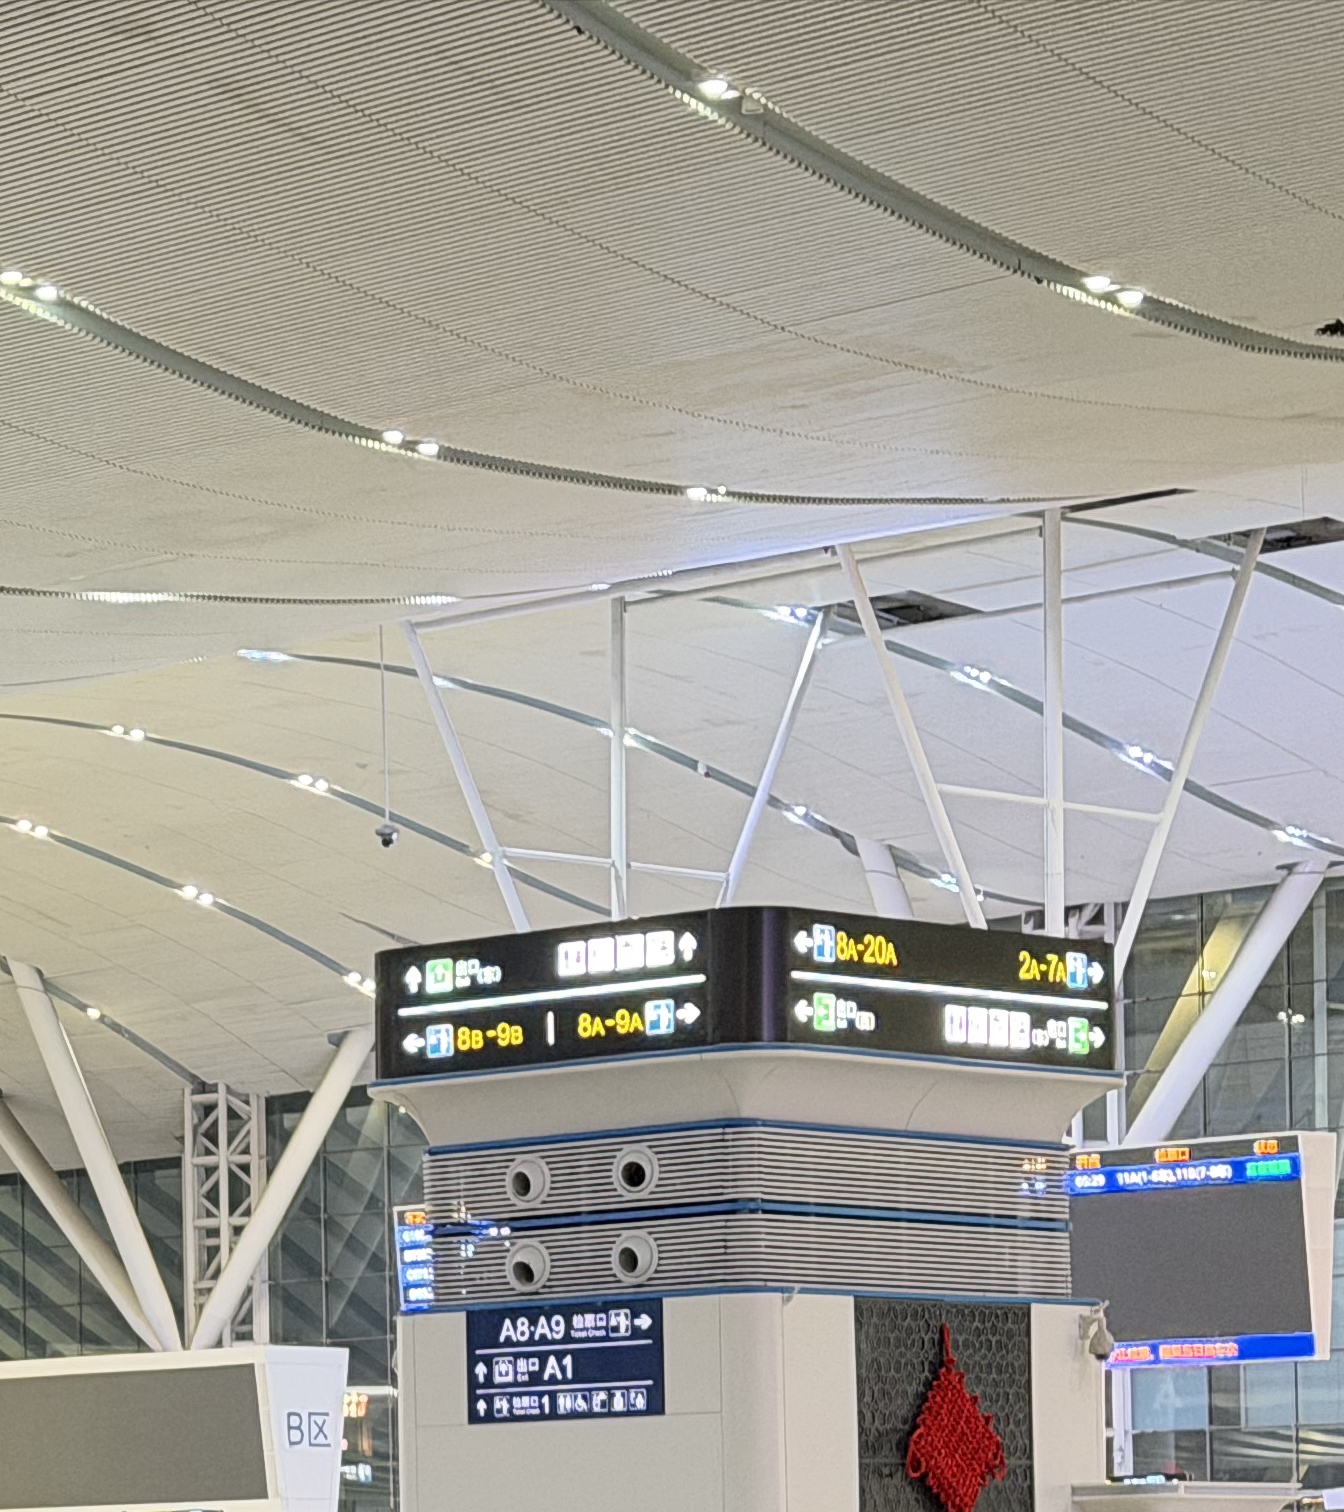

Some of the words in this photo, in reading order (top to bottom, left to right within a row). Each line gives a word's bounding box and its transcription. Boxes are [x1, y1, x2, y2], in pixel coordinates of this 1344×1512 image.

[836, 931, 898, 967] 8A-20A
[1018, 950, 1067, 983] 2A-7A
[457, 1022, 524, 1050] 8B-9B
[577, 1008, 645, 1038] 8A-9A
[517, 1357, 540, 1373] 出口
[543, 1354, 573, 1381] A1
[286, 1411, 332, 1447] B区
